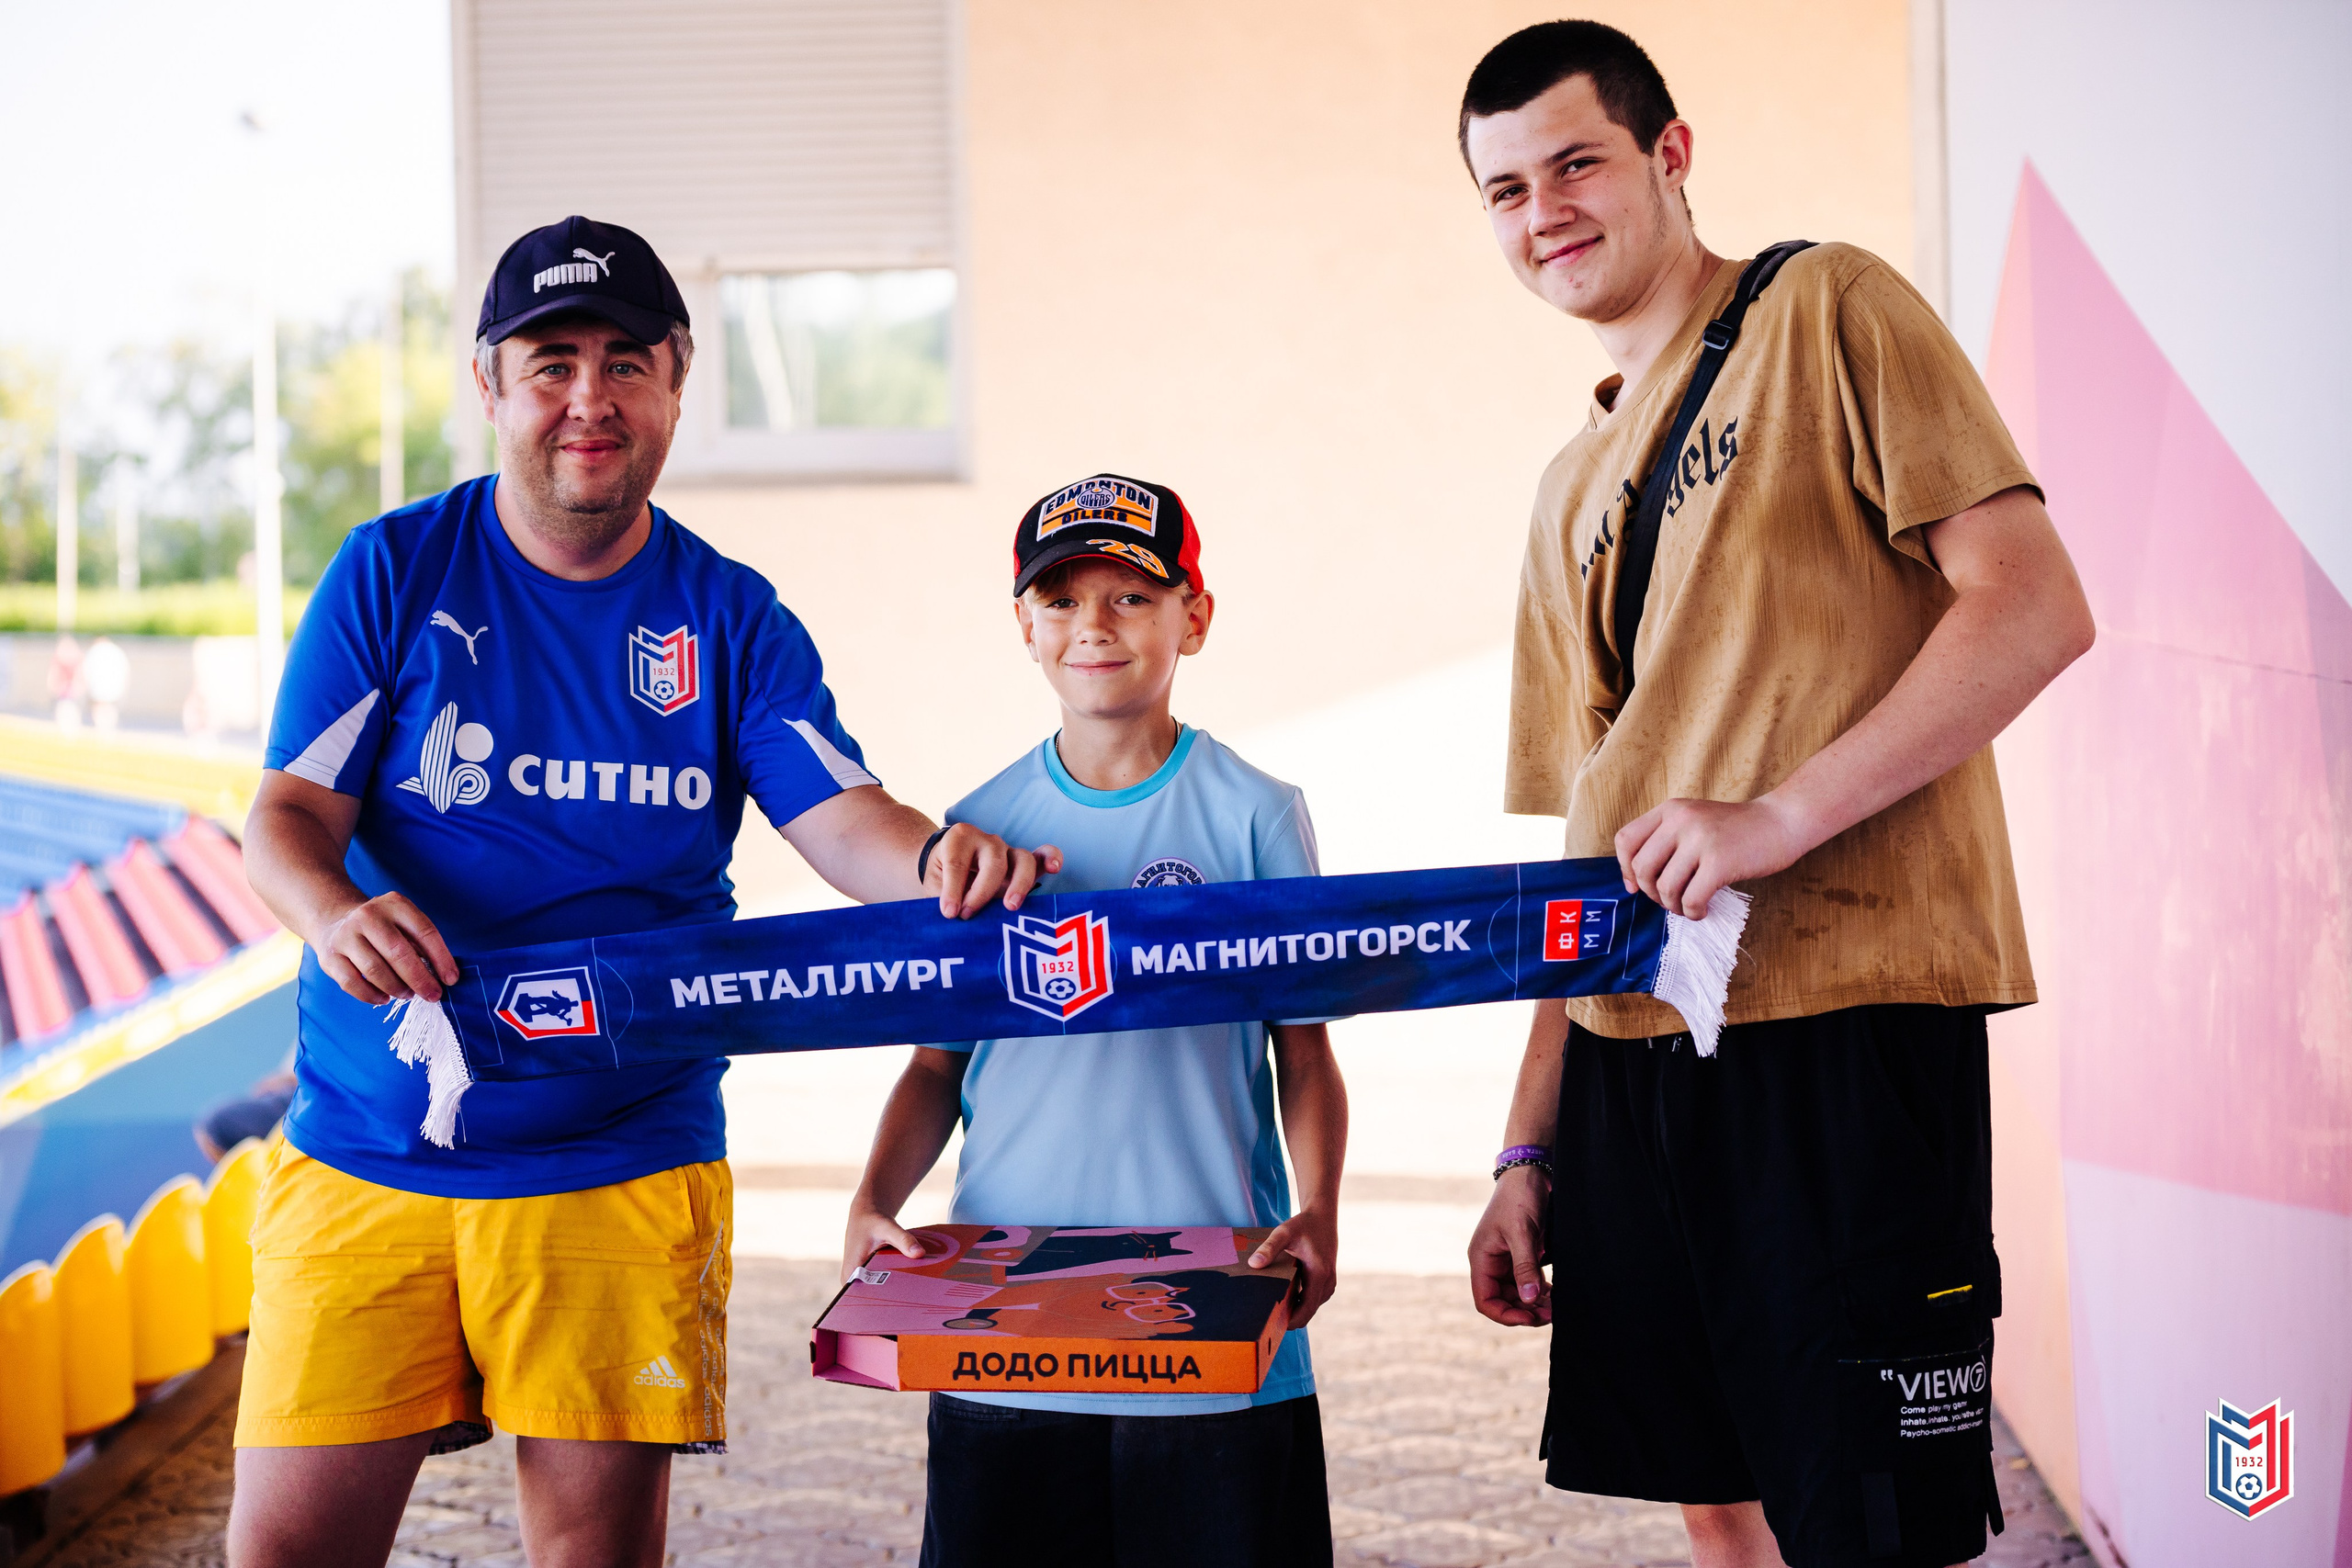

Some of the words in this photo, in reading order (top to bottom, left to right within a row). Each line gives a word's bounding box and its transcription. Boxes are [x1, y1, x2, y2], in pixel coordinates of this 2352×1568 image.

[534, 263, 597, 293] PUMA
[1046, 479, 1151, 514] EDMONTON
[1081, 493, 1111, 507] OILERS
[1062, 510, 1127, 525] OILERS
[653, 668, 675, 676] 1932
[1134, 862, 1203, 888] АГНИТОГОР
[670, 957, 964, 1008] МЕТАЛЛУРГ
[1131, 919, 1471, 976] МАГНИТОГОРСК
[1041, 961, 1075, 975] 1932
[953, 1351, 1058, 1382] ДОДО
[1068, 1352, 1202, 1383] ПИЦЦА
[634, 1374, 685, 1388] adidas
[704, 1386, 712, 1437] adidas
[1901, 1405, 1926, 1415] Come
[1928, 1405, 1941, 1414] play
